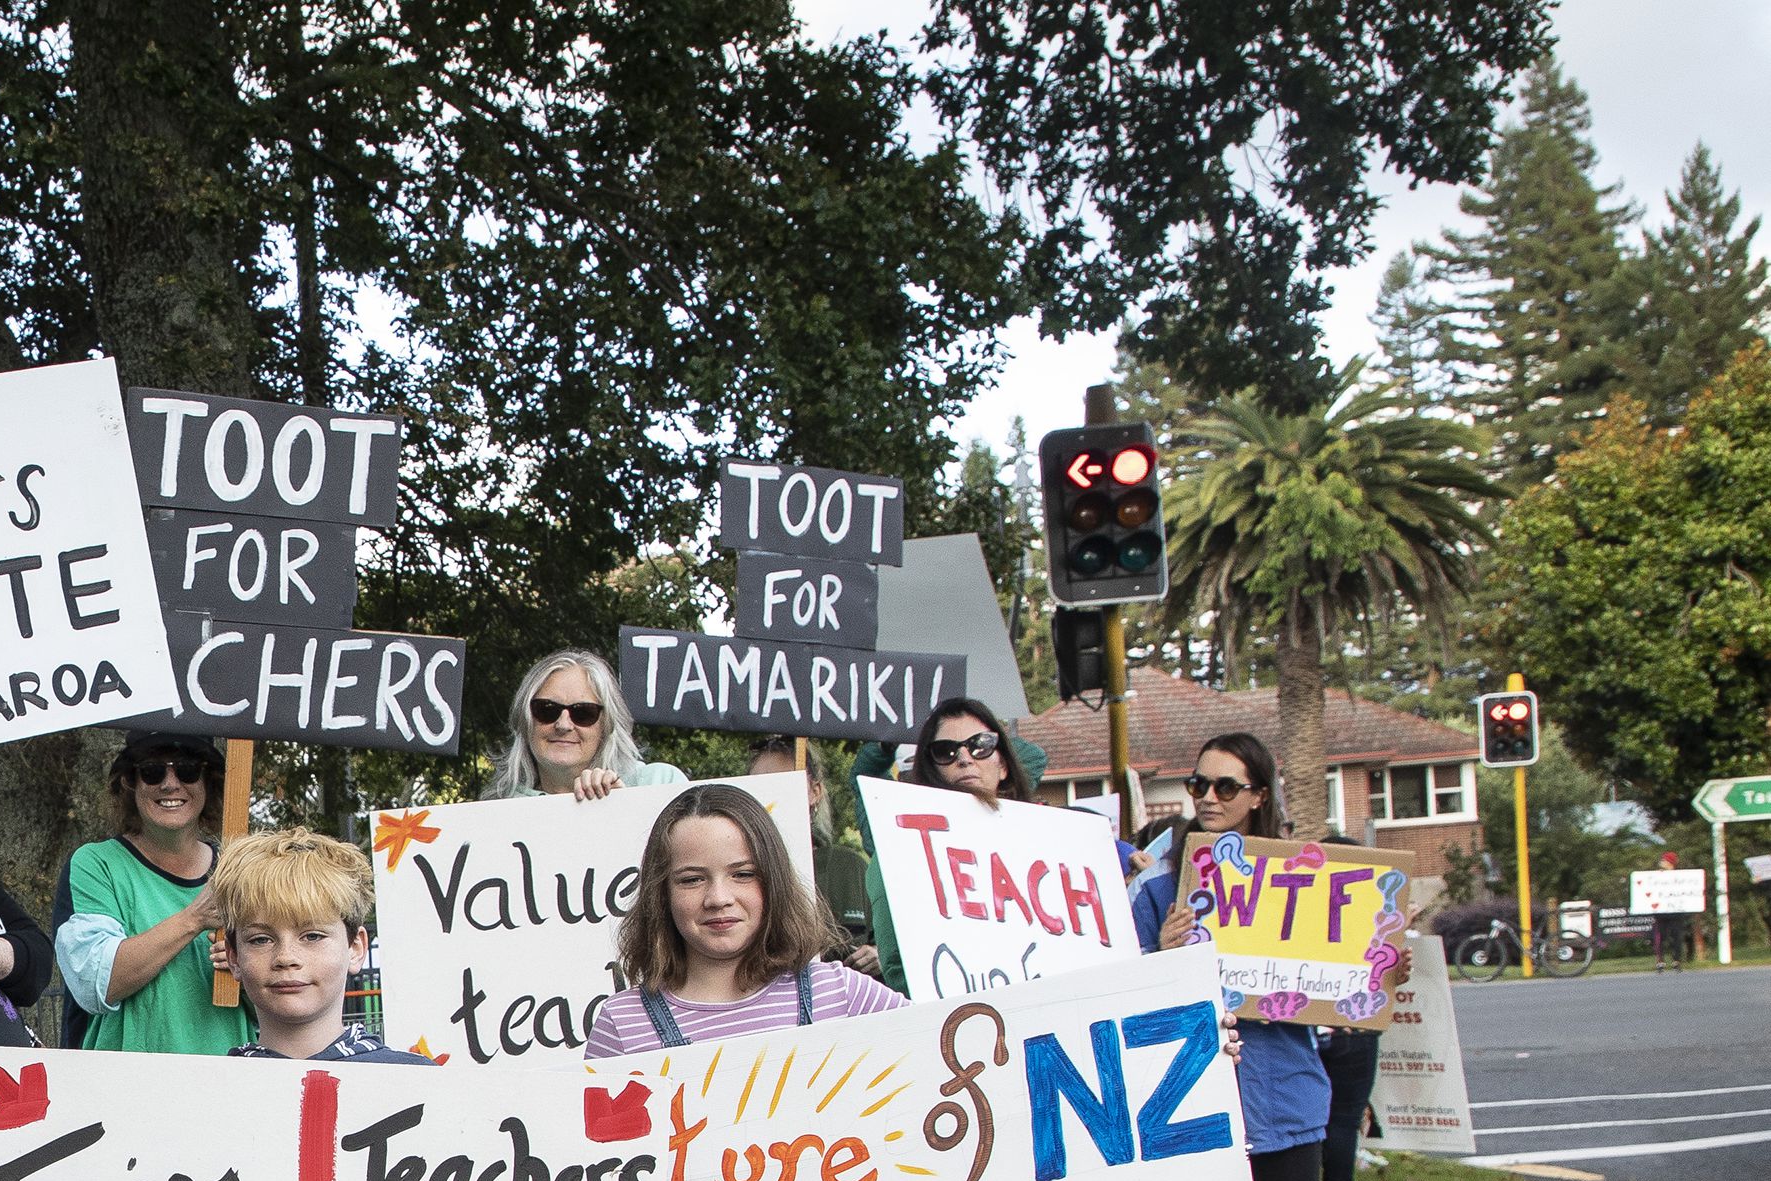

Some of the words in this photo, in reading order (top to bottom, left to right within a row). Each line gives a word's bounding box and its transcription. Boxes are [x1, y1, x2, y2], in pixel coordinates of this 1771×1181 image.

[142, 397, 396, 516] TOOT
[727, 463, 903, 555] TOOT
[182, 523, 315, 606] FOR
[762, 570, 843, 632] FOR
[173, 630, 458, 756] CHERS
[414, 839, 641, 934] Value
[895, 814, 1112, 948] TEACH
[1212, 855, 1375, 944] WTF
[1217, 958, 1258, 989] here's
[1263, 960, 1289, 990] the
[1296, 962, 1342, 997] funding
